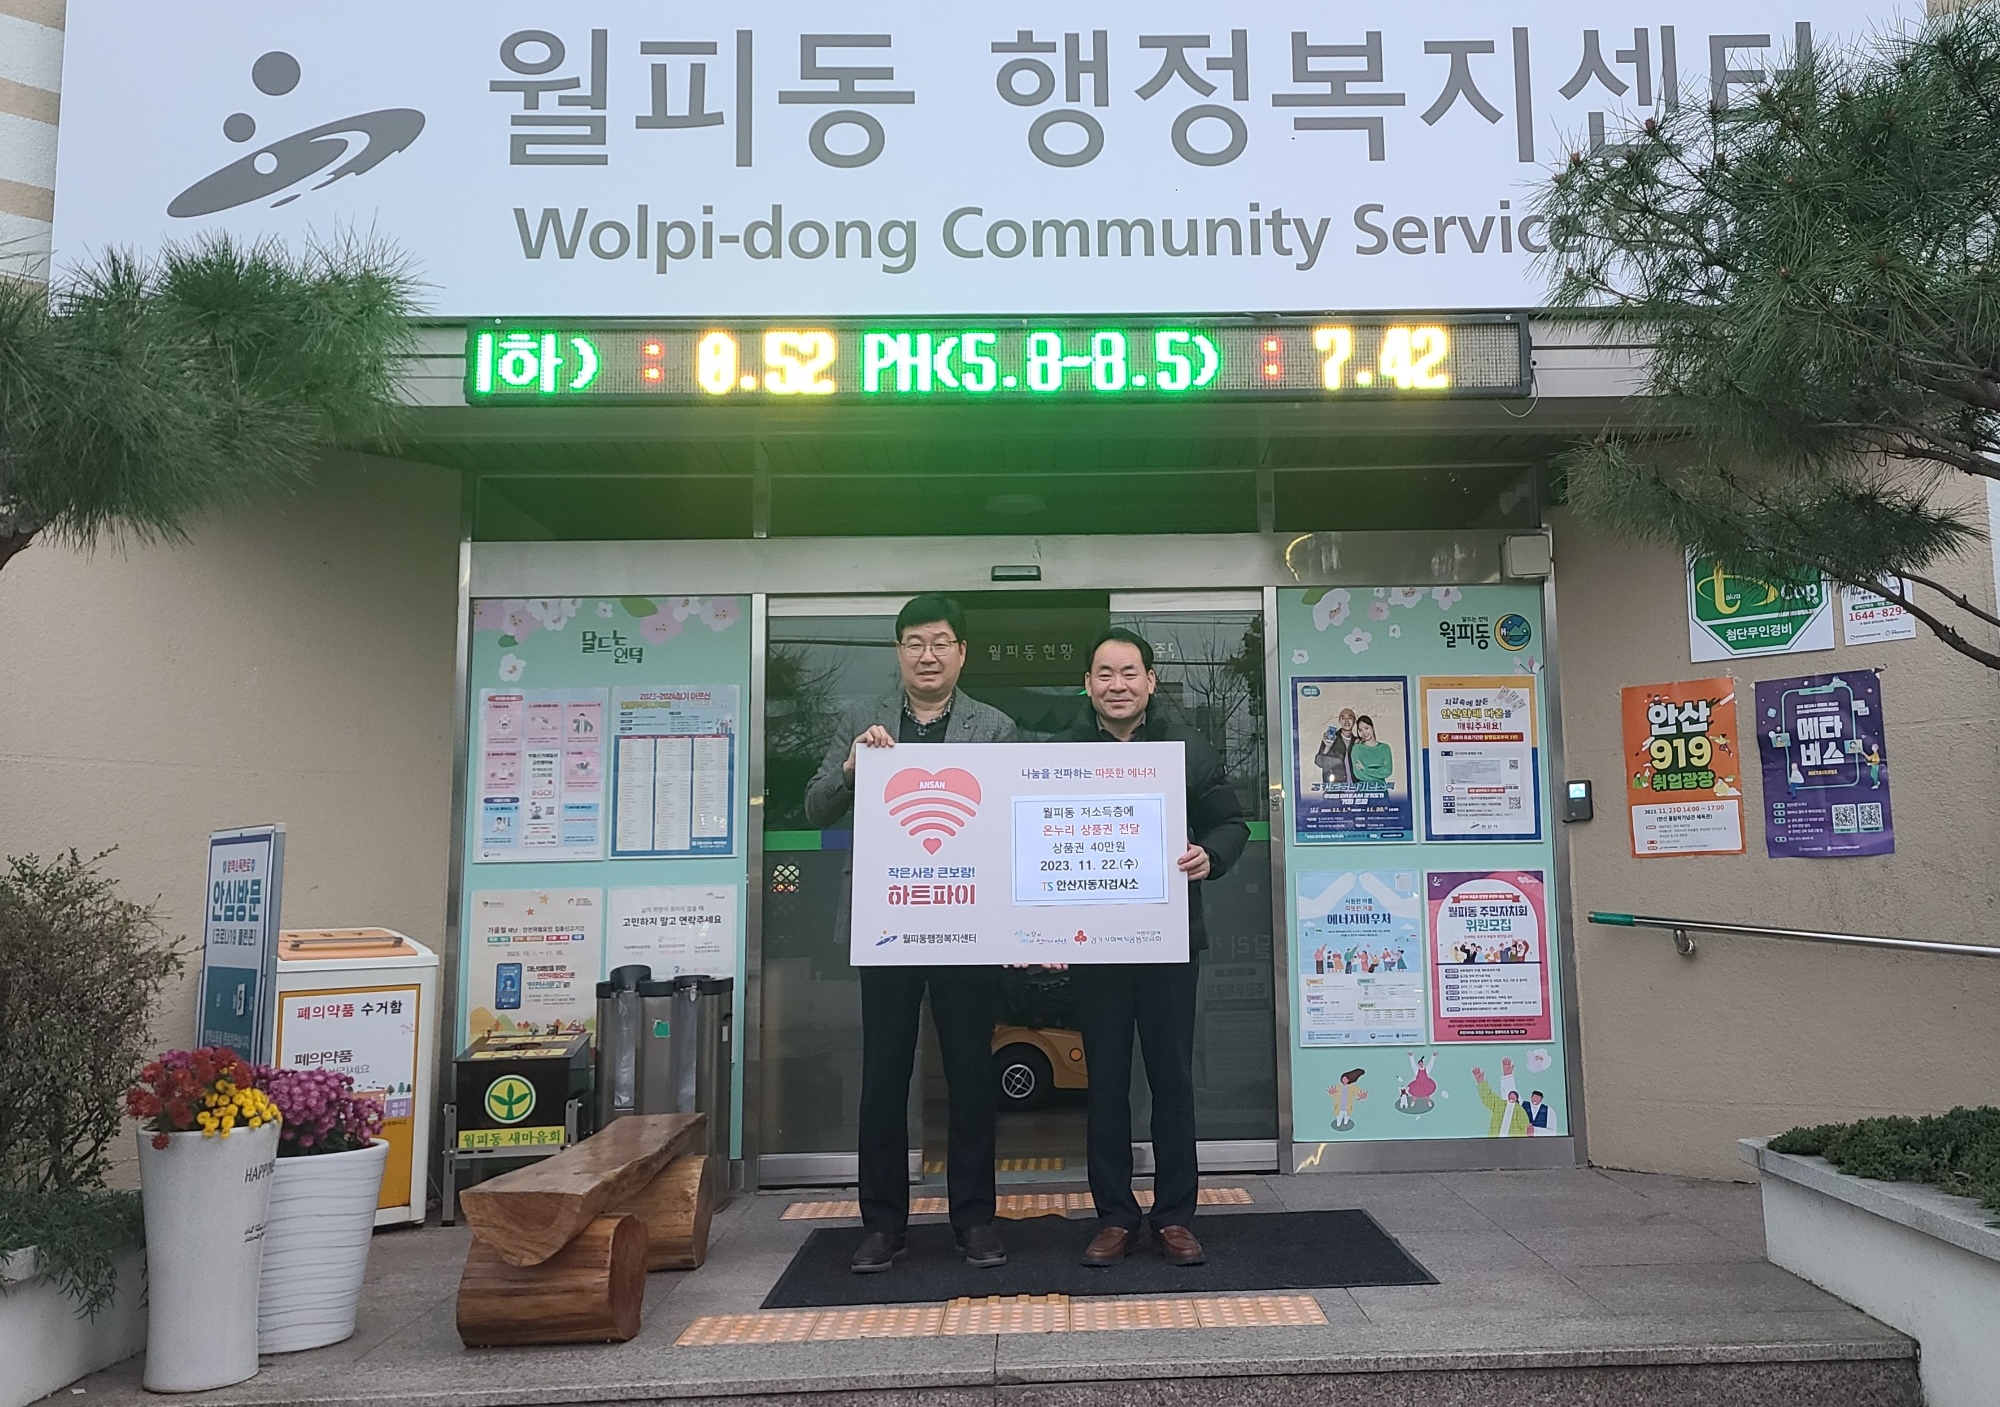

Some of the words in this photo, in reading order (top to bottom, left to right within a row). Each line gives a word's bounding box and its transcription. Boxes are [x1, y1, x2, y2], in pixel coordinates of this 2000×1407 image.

[489, 28, 915, 168] 월피동
[514, 205, 917, 274] Wolpi-dong
[942, 203, 1328, 271] Community
[698, 332, 837, 394] 0.52
[1314, 326, 1452, 391] 7.42
[1439, 621, 1490, 650] 월피동
[1725, 621, 1793, 643] 첨단무인경비
[988, 644, 1036, 661] 월피동
[1042, 643, 1074, 661] 현황
[1457, 721, 1502, 730] 깨워주세요!
[1648, 700, 1711, 736] 안산
[1796, 715, 1843, 741] 메타
[1650, 736, 1712, 770] 919
[1800, 741, 1845, 766] 버스
[1021, 768, 1051, 779] 나눔을
[1053, 767, 1093, 779] 전파하는
[1095, 767, 1125, 779] 따뜻한
[1127, 767, 1157, 779] 에너지
[1652, 771, 1715, 790] 취업광장
[919, 780, 946, 789] ANSAN
[1042, 807, 1075, 818] 월피동
[1081, 805, 1134, 818] 저소득층에
[1042, 824, 1075, 836] 온누리
[1081, 823, 1113, 836] 상품권
[1118, 823, 1140, 835] 전달
[1052, 842, 1084, 854] 상품권
[1090, 841, 1126, 853] 40만원
[888, 866, 934, 879] 작은사랑
[936, 866, 976, 878] 큰보람!
[1040, 860, 1074, 872] 2023.
[1078, 860, 1096, 871] 11.
[212, 879, 261, 922] 안심방문
[887, 884, 976, 905] 하트파이
[1327, 913, 1391, 925] 에너지바우처
[1448, 906, 1478, 917] 월피동
[1479, 905, 1528, 917] 주민자치회
[622, 917, 657, 927] 고민하지
[660, 916, 677, 926] 말고
[679, 915, 722, 925] 연락주세요
[1466, 918, 1512, 932] 위원모집
[902, 933, 977, 945] 월피동행정복지센터
[297, 1003, 354, 1020] 폐의약품
[360, 1000, 403, 1016] 수거함
[294, 1050, 353, 1066] 폐의약품
[462, 1132, 503, 1148] 월피동
[508, 1130, 561, 1145] 새마을회
